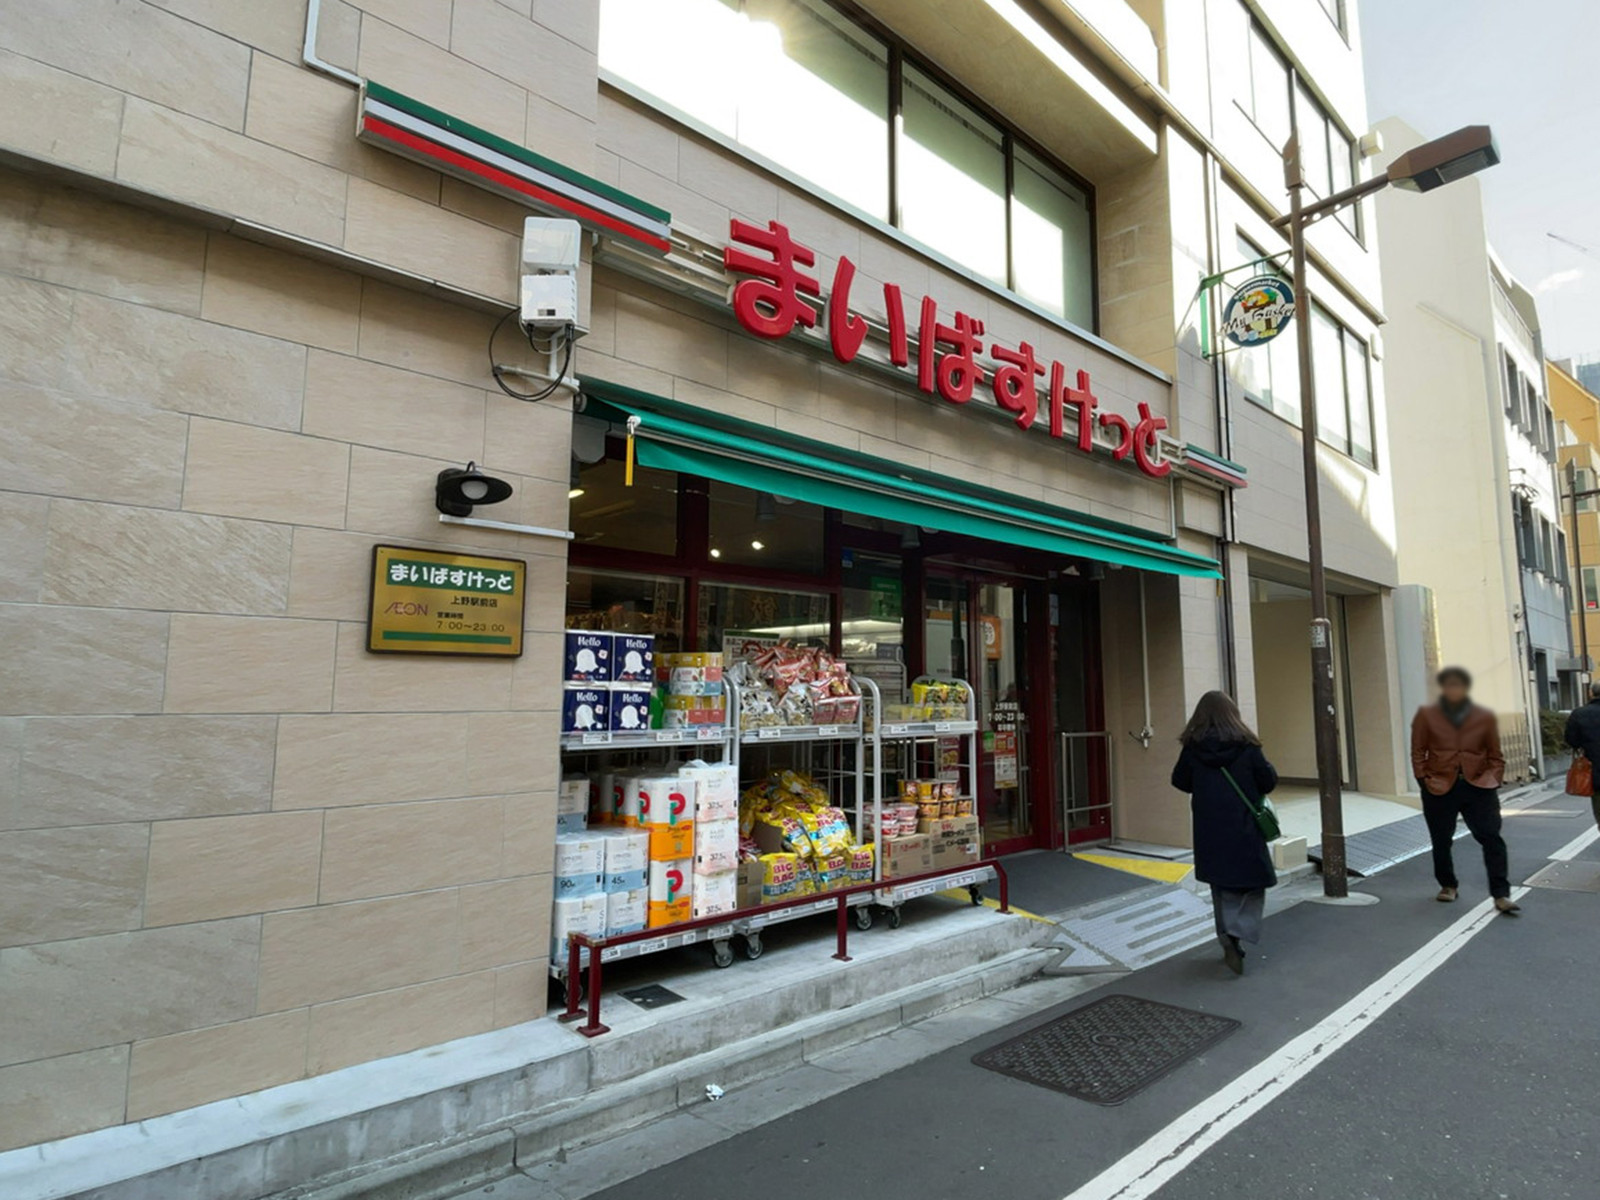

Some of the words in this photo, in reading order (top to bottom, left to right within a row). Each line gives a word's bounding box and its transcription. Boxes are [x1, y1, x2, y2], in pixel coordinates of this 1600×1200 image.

[724, 219, 1172, 478] まいばすけっと
[390, 563, 512, 591] まいばすけっと
[450, 595, 498, 608] 上野駅前店
[577, 636, 602, 648] Hello
[626, 638, 648, 650] Hello
[576, 692, 599, 703] Hello
[622, 693, 643, 703] Hello
